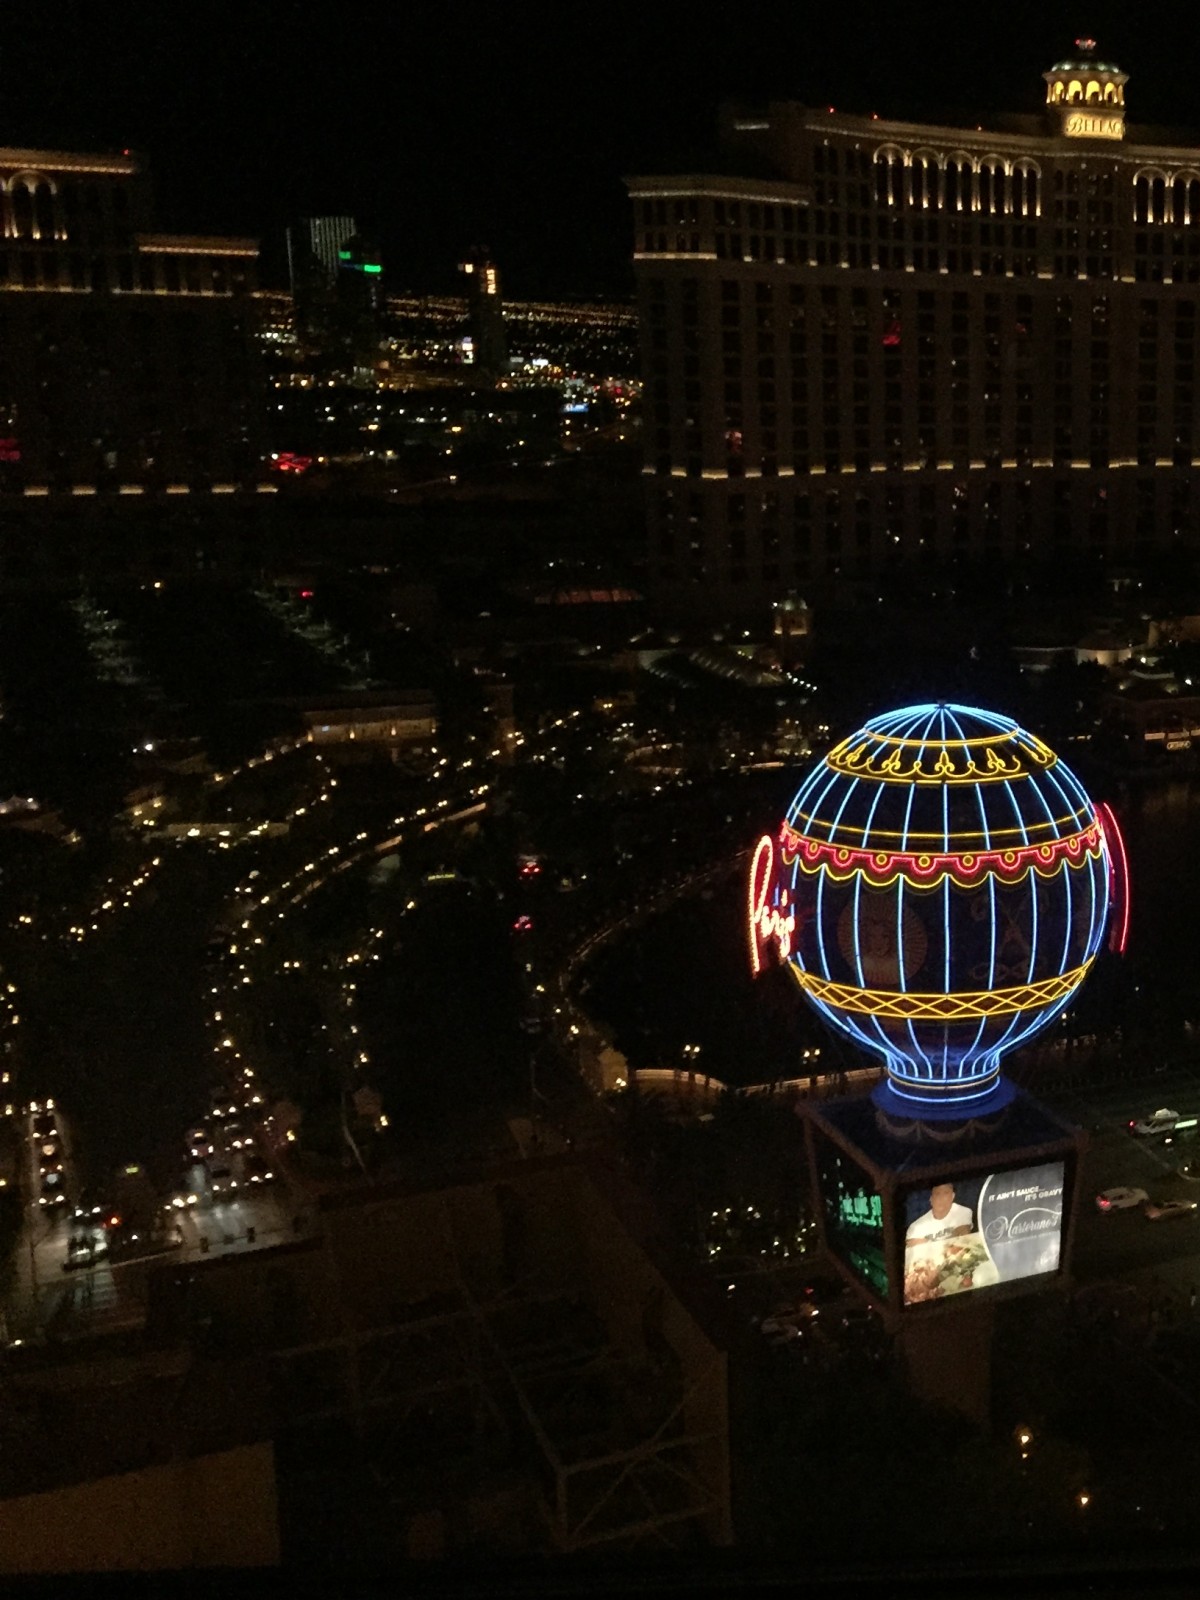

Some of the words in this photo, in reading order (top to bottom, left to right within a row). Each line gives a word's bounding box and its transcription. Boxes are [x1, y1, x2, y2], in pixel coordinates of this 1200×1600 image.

[988, 1194, 996, 1203] IT
[996, 1190, 1015, 1201] AIN'T
[1024, 1193, 1037, 1202] IT'S
[1038, 1187, 1063, 1199] GRAVY
